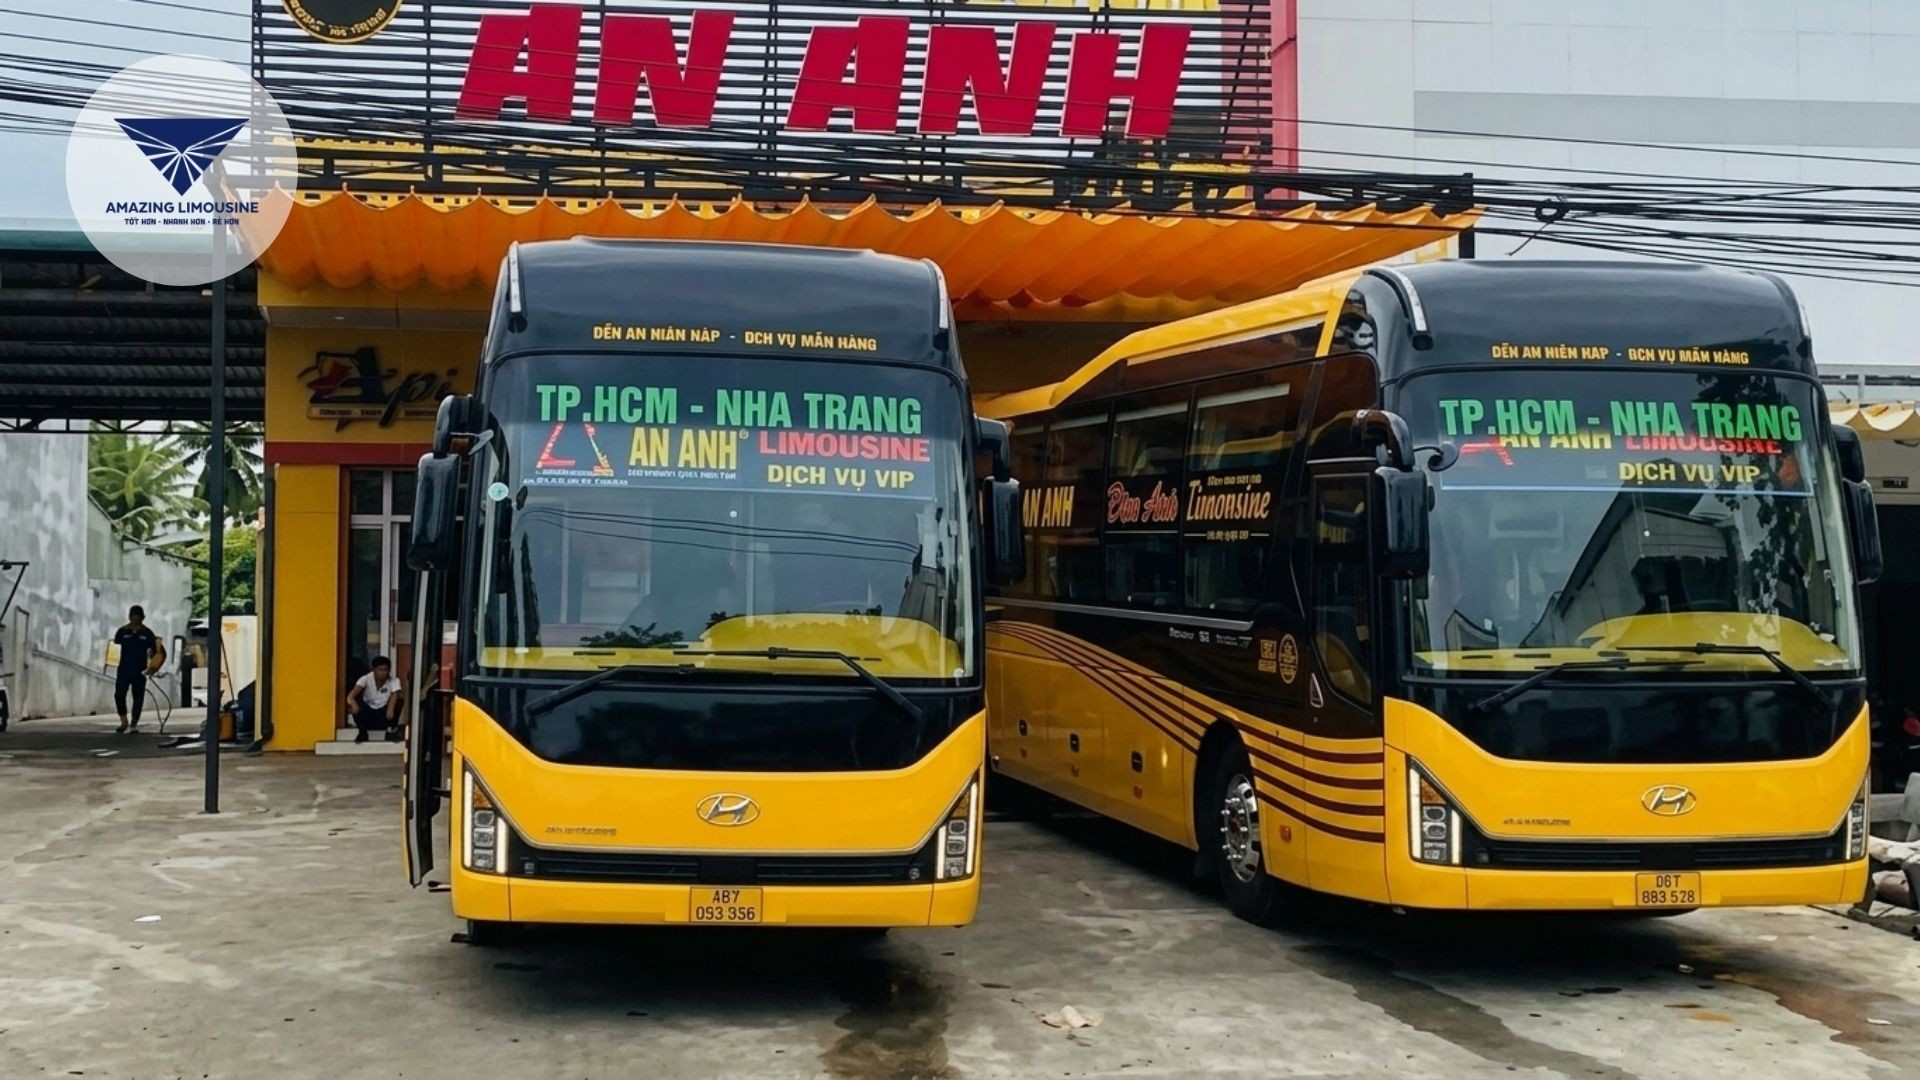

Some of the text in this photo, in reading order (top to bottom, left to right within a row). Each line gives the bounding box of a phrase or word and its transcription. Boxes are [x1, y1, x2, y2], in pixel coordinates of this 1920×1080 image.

[455, 3, 1192, 140] AN ANH
[625, 327, 646, 340] AN
[536, 384, 677, 424] TP.HCM
[716, 388, 793, 429] NHA
[803, 392, 922, 435] TRANG
[1439, 399, 1578, 436] TP.HCM
[1610, 400, 1686, 437] NHA
[1691, 402, 1802, 441] TRANG
[628, 426, 670, 468] AN
[759, 430, 931, 463] LIMOUSINE
[767, 464, 915, 492] DỊCH VỤ VIP
[1720, 464, 1761, 483] VIP
[1041, 485, 1075, 528] ANH
